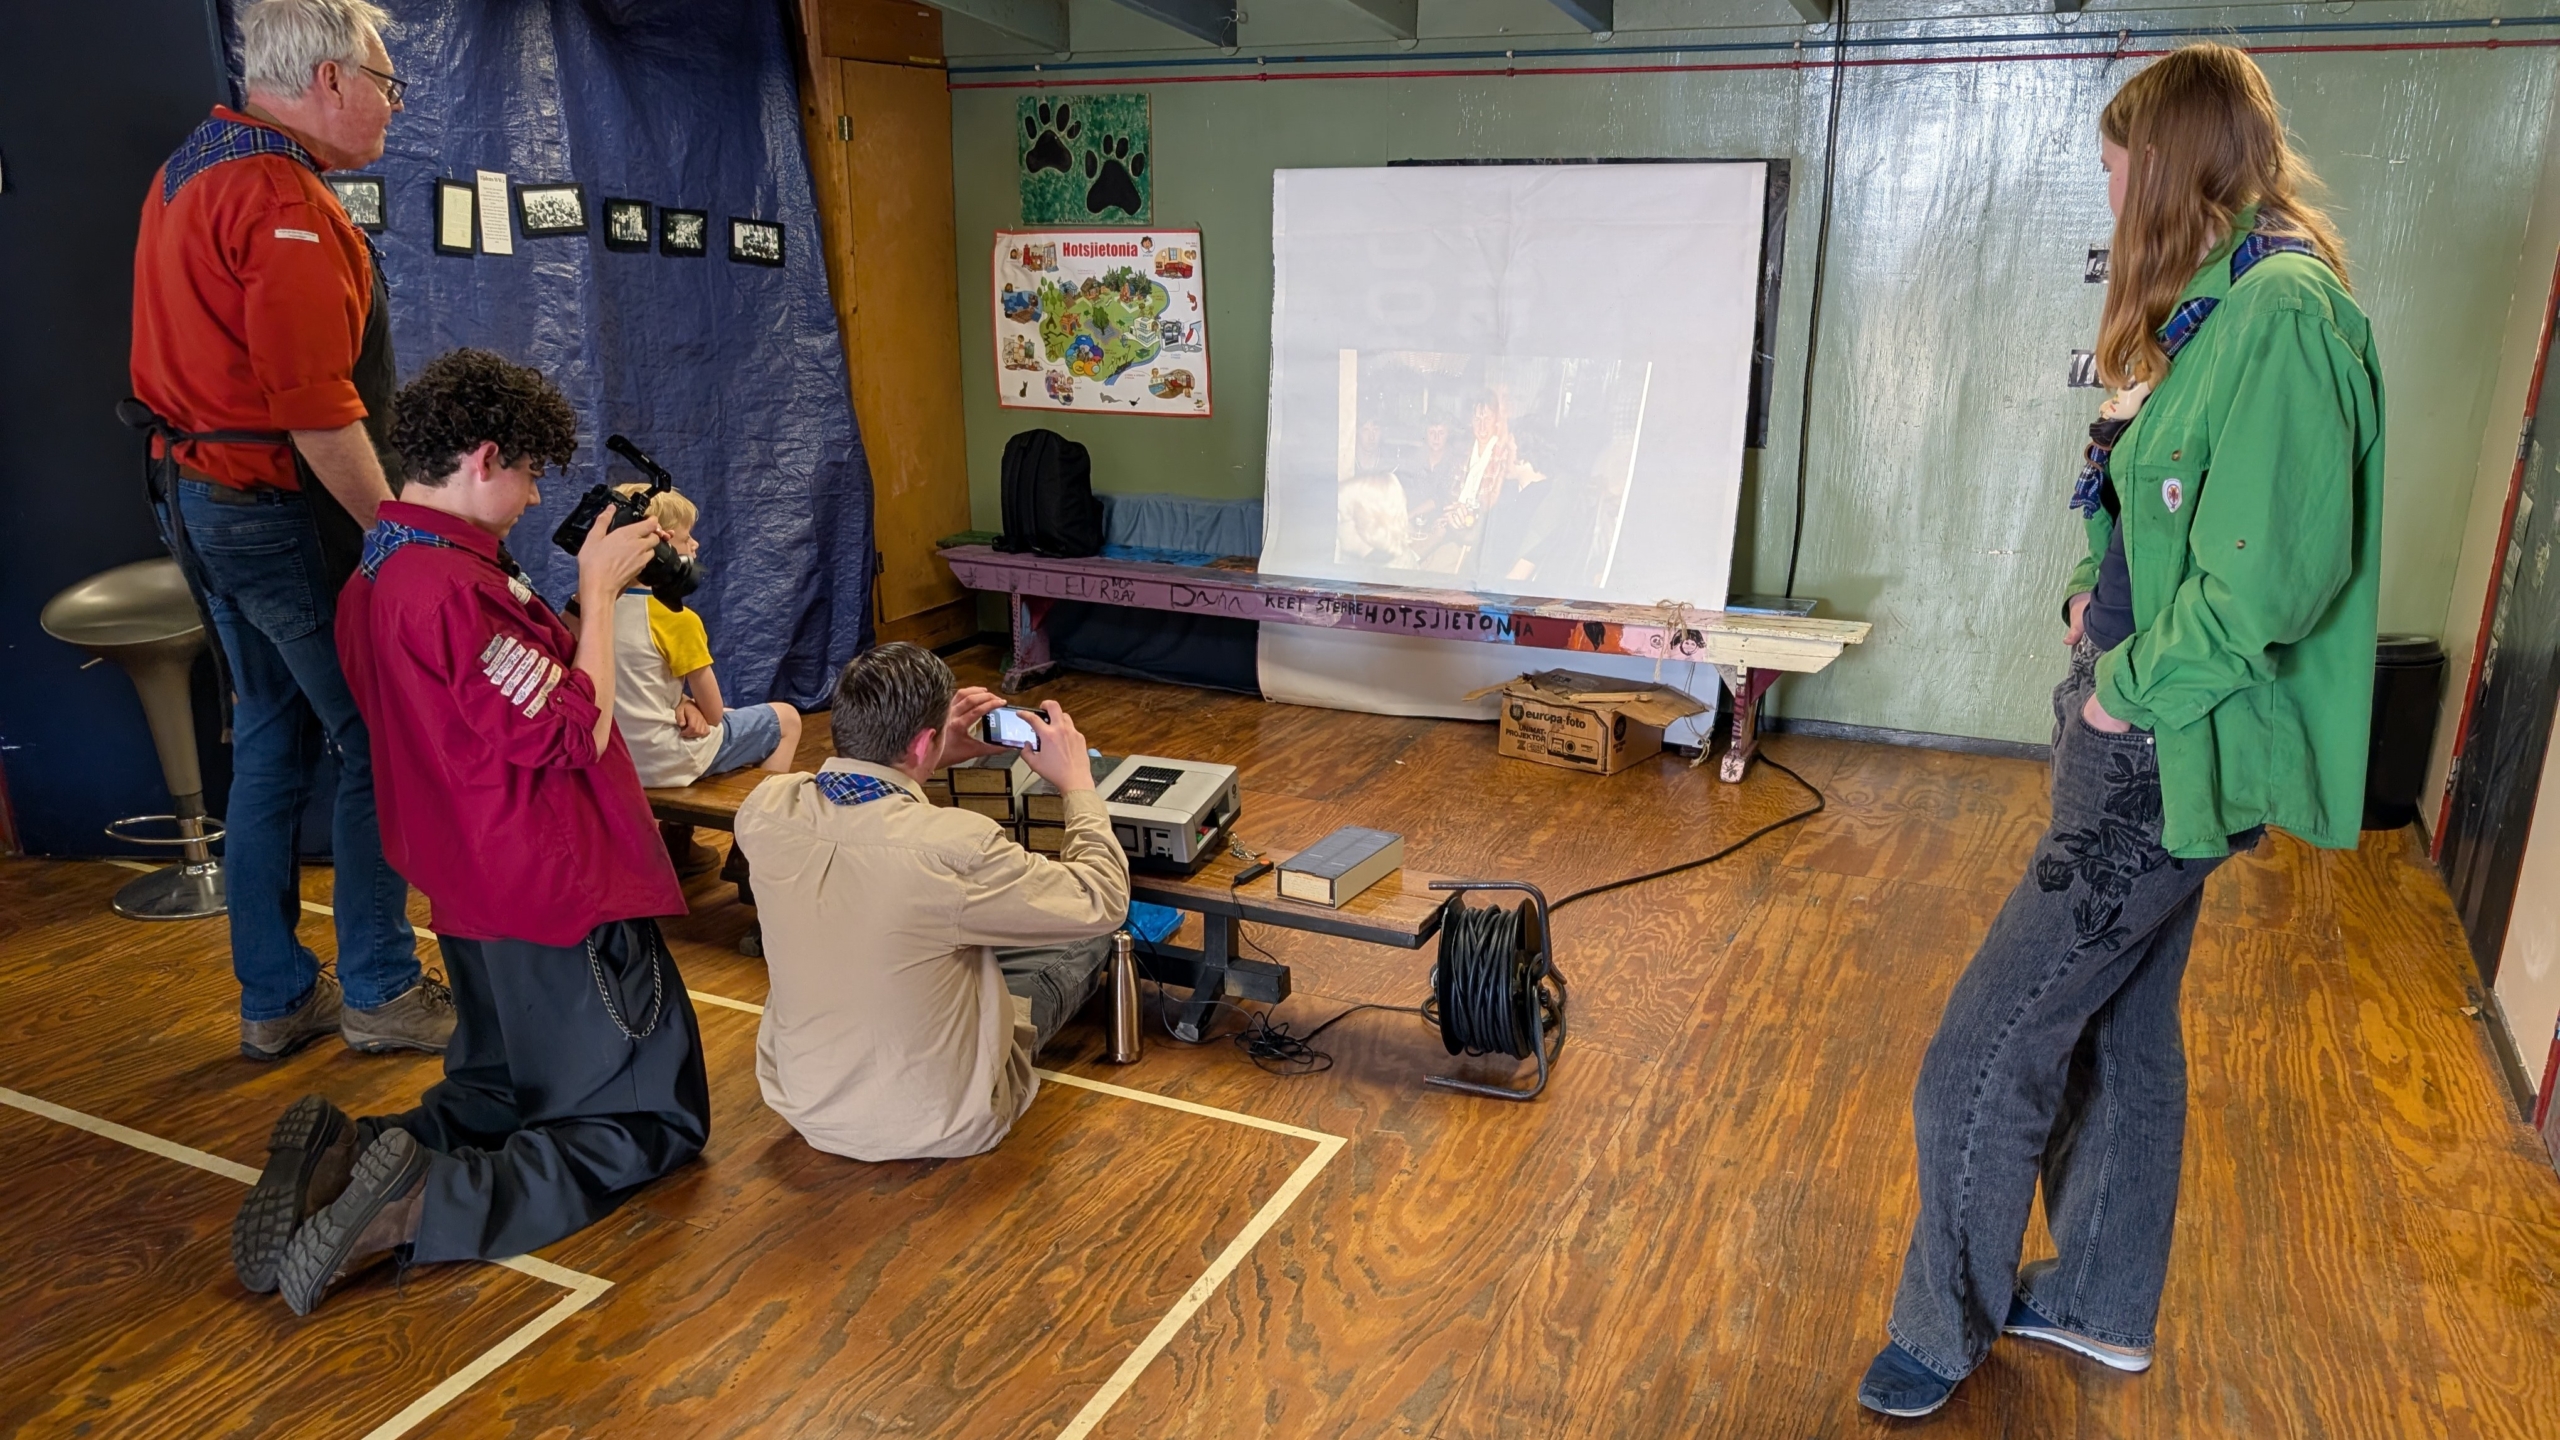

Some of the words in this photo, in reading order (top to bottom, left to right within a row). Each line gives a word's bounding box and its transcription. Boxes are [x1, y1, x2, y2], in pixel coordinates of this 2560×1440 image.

[1063, 242, 1138, 258] Hotsjietonia
[1028, 573, 1111, 601] FLEUR
[1265, 594, 1303, 612] KEET
[1526, 710, 1586, 729] europa-foto
[1505, 728, 1546, 743] PROJEKTOR
